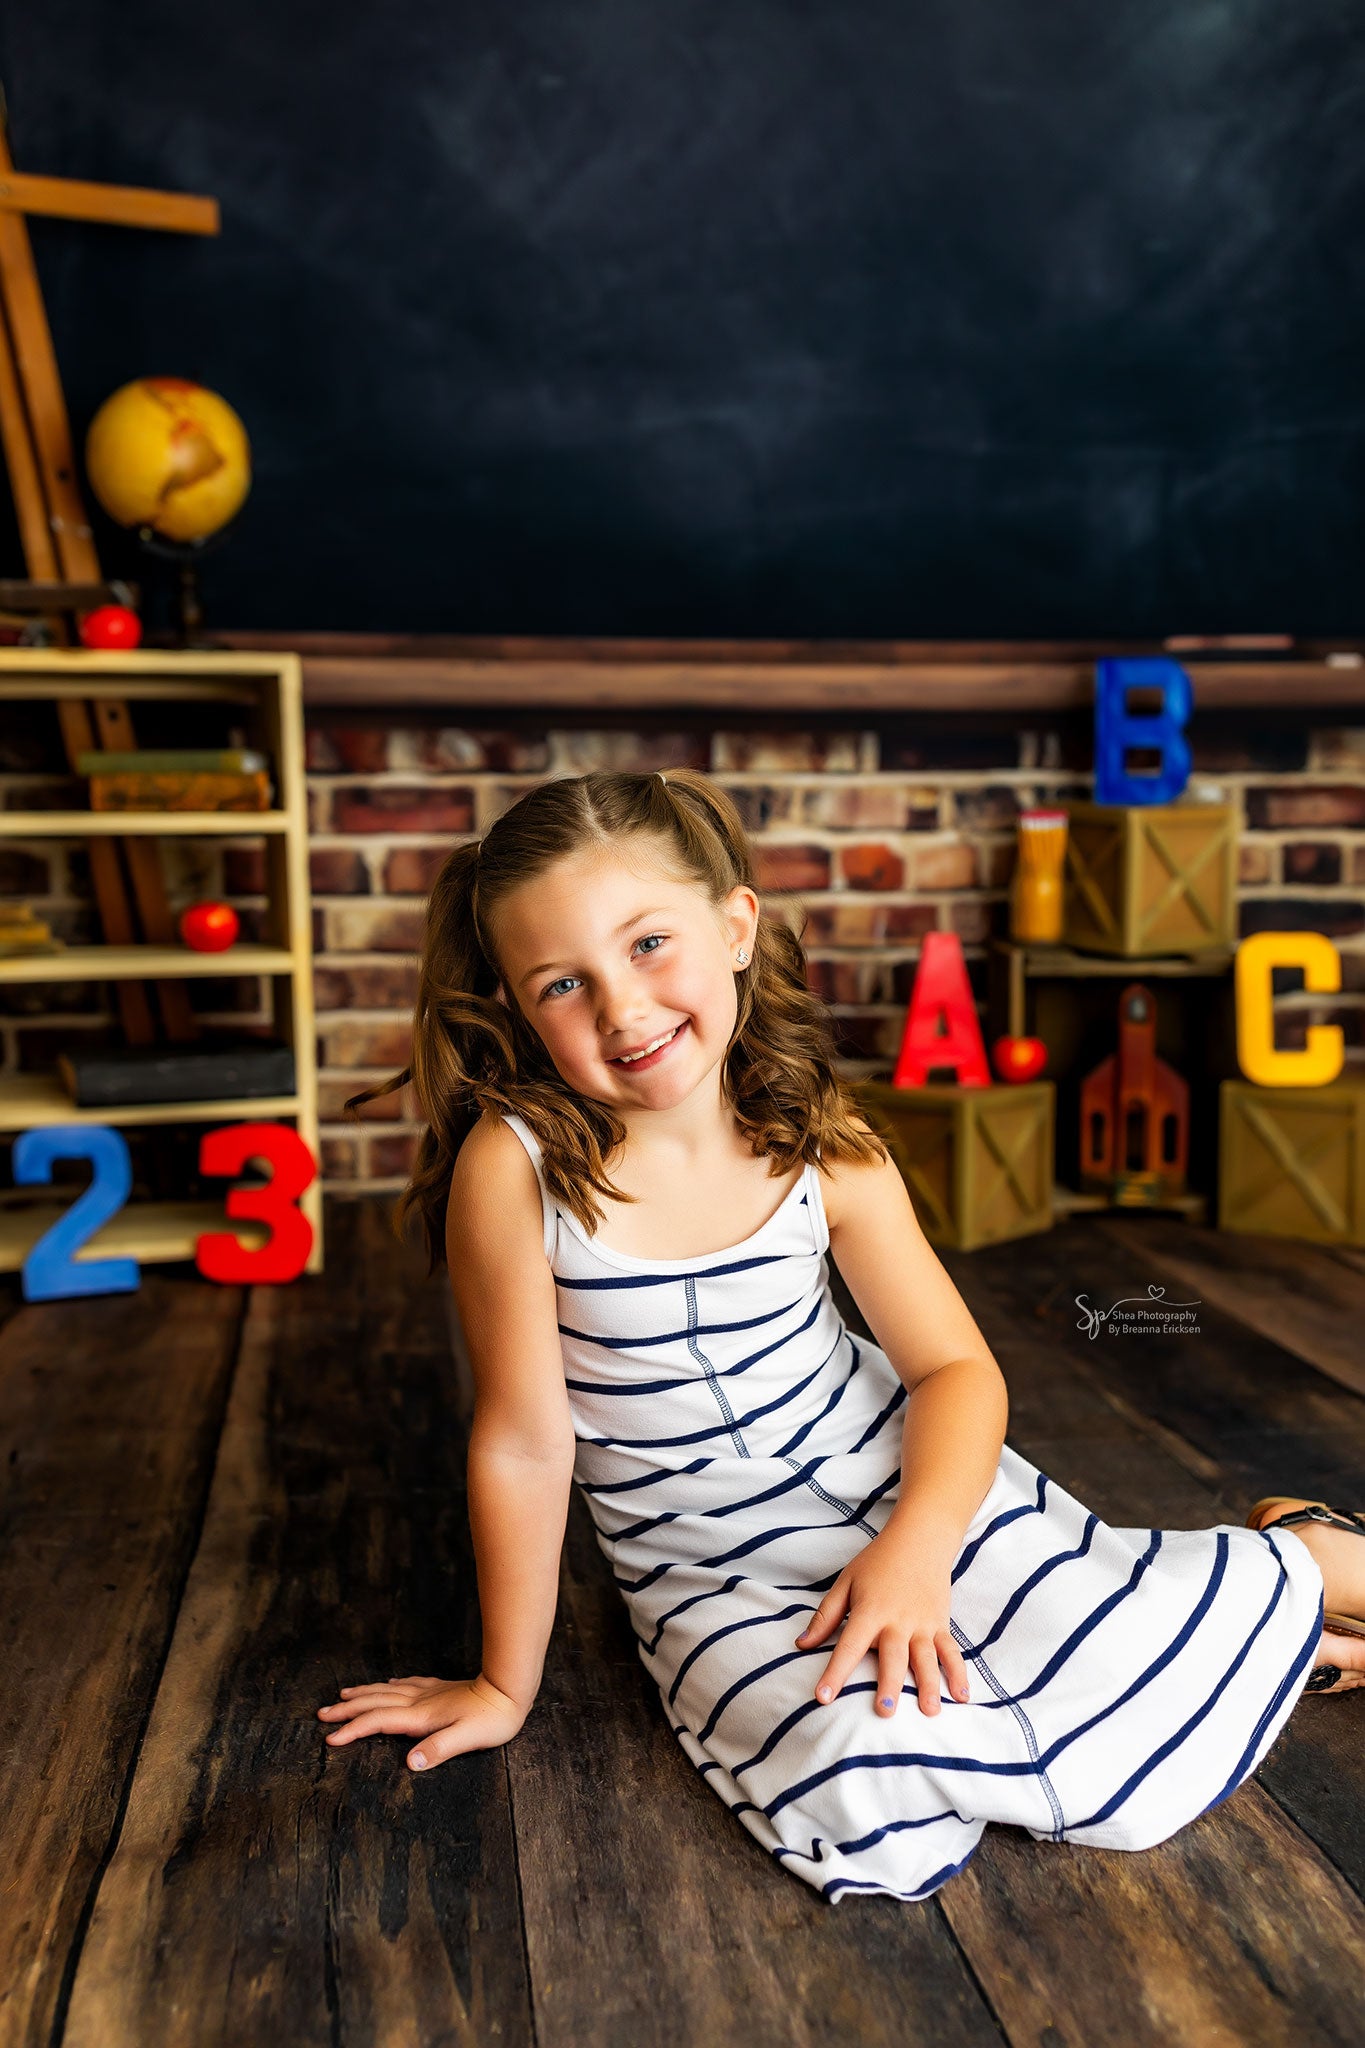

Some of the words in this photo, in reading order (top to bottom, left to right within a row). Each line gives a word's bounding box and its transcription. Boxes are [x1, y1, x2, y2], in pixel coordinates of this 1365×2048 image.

[1094, 656, 1194, 806] B
[893, 932, 992, 1087] A
[1235, 932, 1345, 1087] C
[13, 1125, 140, 1301] 2
[196, 1122, 317, 1284] 3
